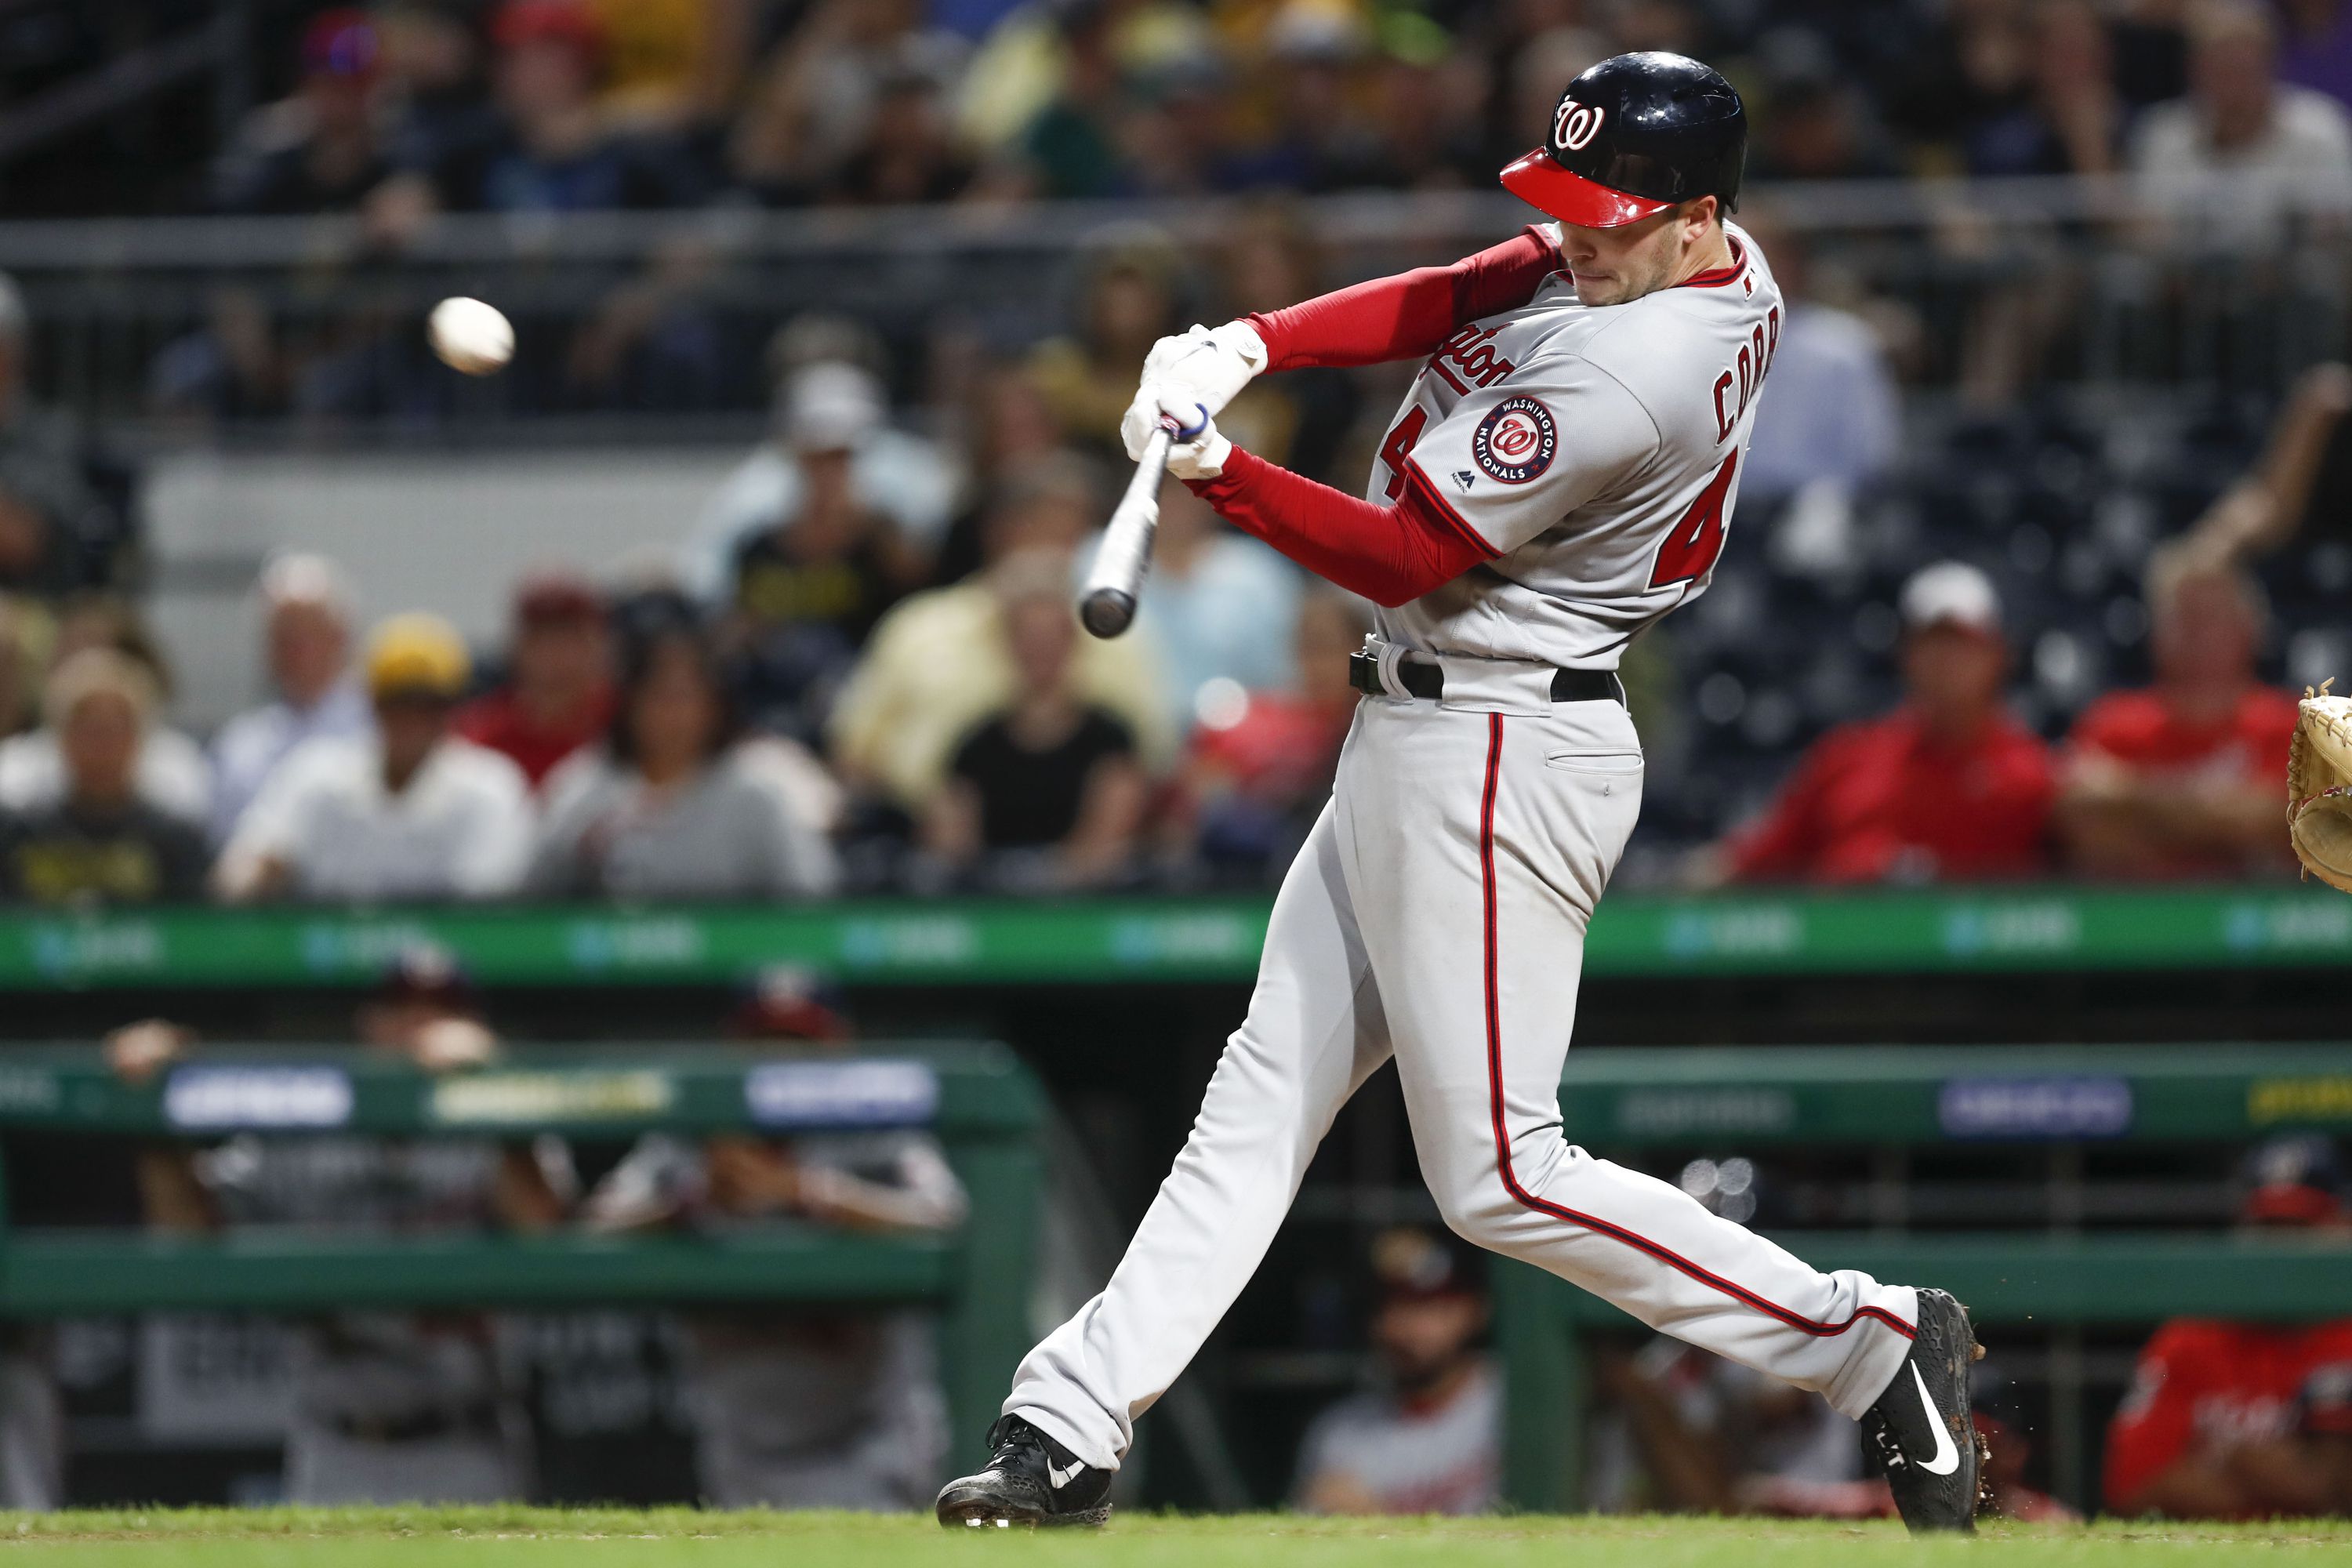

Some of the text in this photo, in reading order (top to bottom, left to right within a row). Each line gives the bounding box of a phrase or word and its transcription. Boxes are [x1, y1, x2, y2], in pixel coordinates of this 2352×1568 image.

[1555, 100, 1605, 151] W
[1378, 401, 1428, 502] 4
[1475, 427, 1526, 479] NATIONALS
[1493, 419, 1537, 456] W
[1502, 399, 1554, 459] WASHINGTON
[1642, 442, 1739, 600] 4
